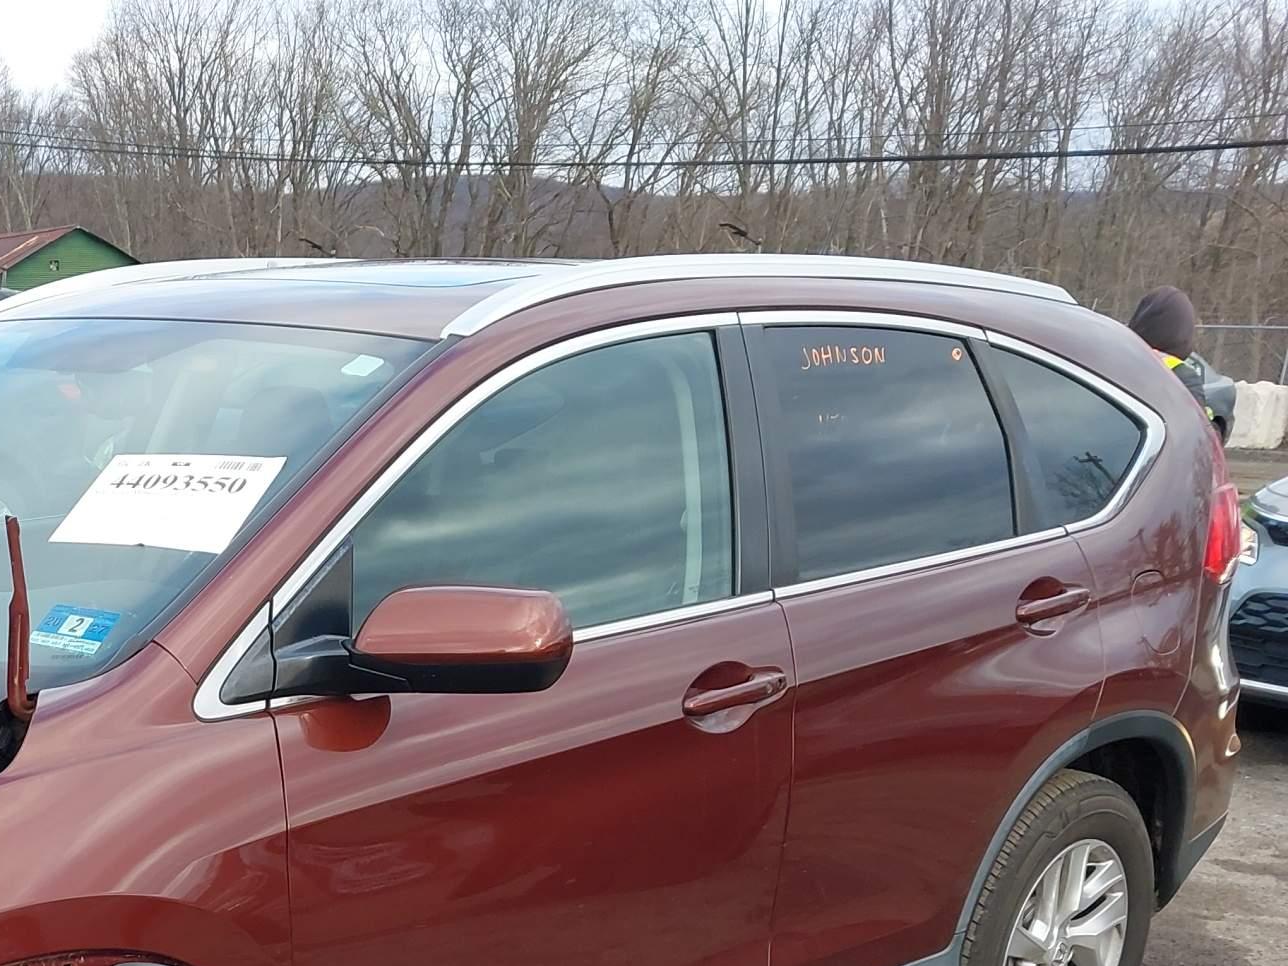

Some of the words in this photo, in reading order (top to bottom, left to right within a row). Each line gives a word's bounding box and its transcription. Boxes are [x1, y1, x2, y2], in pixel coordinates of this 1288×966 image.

[801, 345, 886, 370] JOHNSON
[110, 473, 248, 494] 44093550
[68, 617, 85, 633] 2
